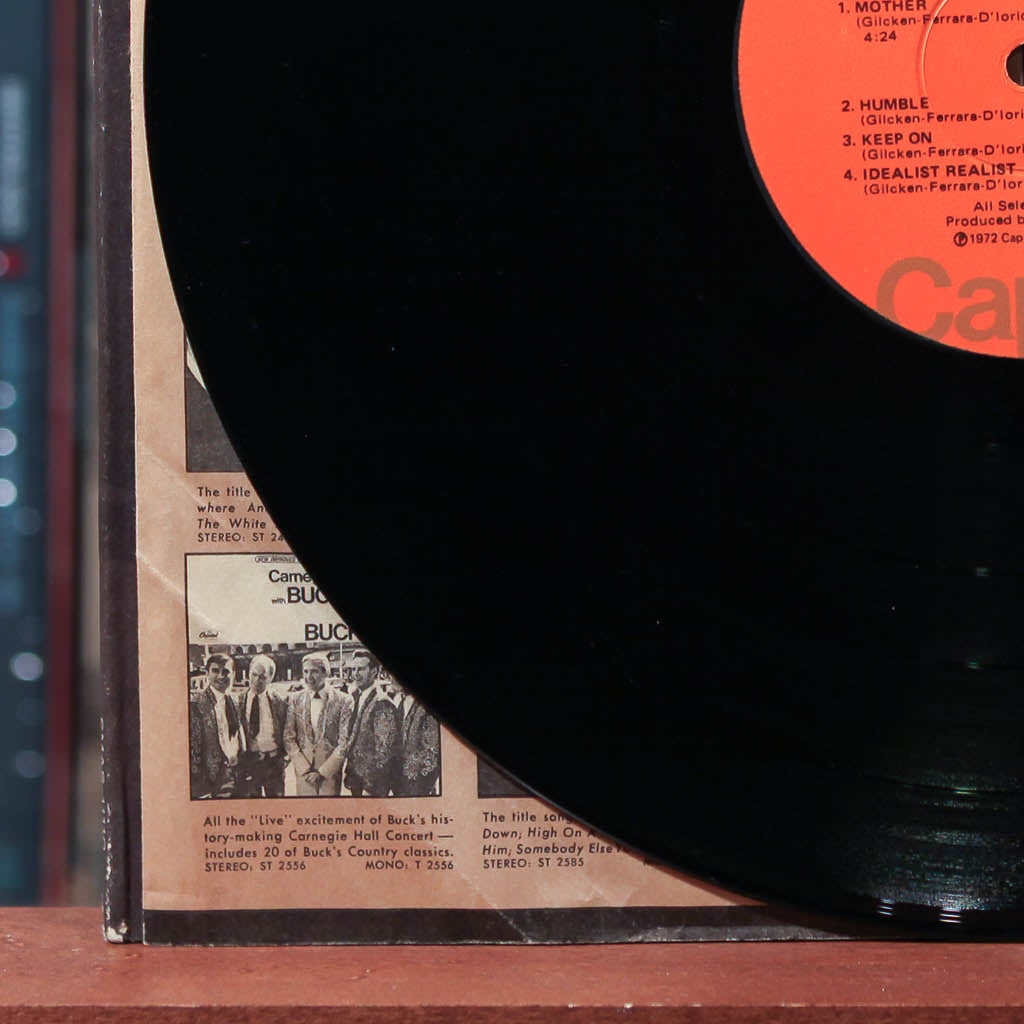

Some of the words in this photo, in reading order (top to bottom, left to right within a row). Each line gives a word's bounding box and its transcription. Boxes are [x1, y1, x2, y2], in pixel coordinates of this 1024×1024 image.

[838, 2, 849, 13] 1.
[856, 0, 926, 12] MOTHER
[864, 31, 896, 42] 4:24
[842, 100, 854, 112] 2.
[860, 97, 928, 111] HUMBLE
[843, 135, 855, 146] 3.
[862, 133, 903, 145] KEEP
[909, 132, 931, 144] ON
[844, 169, 856, 181] 4.
[864, 166, 939, 180] IDEALIST
[946, 163, 1016, 176] REALIST
[974, 202, 992, 211] All
[946, 215, 1011, 227] Produced
[198, 487, 219, 496] The
[227, 486, 250, 497] title
[197, 502, 235, 512] where
[198, 518, 219, 529] The
[229, 518, 266, 529] White
[198, 533, 244, 542] STEREO:
[252, 533, 264, 542] ST
[204, 816, 220, 826] All
[226, 816, 245, 826] the
[297, 814, 364, 825] excitement
[370, 815, 382, 825] of
[388, 814, 425, 825] Buck's
[432, 814, 453, 824] his-
[483, 812, 505, 822] The
[512, 811, 536, 822] title
[205, 831, 282, 845] tory-making
[289, 830, 347, 844] Carnegie
[354, 830, 378, 840] Hall
[386, 830, 433, 841] Concert
[483, 828, 521, 839] Down;
[528, 827, 557, 840] High
[563, 827, 581, 837] On
[205, 848, 257, 859] includes
[264, 846, 279, 857] 20
[285, 847, 296, 857] of
[304, 846, 341, 857] Buck's
[348, 846, 397, 859] Country
[404, 846, 453, 857] classics.
[483, 845, 511, 856] Him;
[516, 842, 583, 856] Somebody
[589, 843, 612, 853] Else
[205, 862, 252, 872] STEREO:
[260, 861, 272, 871] ST
[279, 861, 306, 870] 2556
[365, 860, 407, 870] MONO:
[428, 860, 453, 870] 2556
[484, 859, 530, 869] STEREO:
[538, 858, 550, 867] ST
[557, 857, 584, 867] 2585
